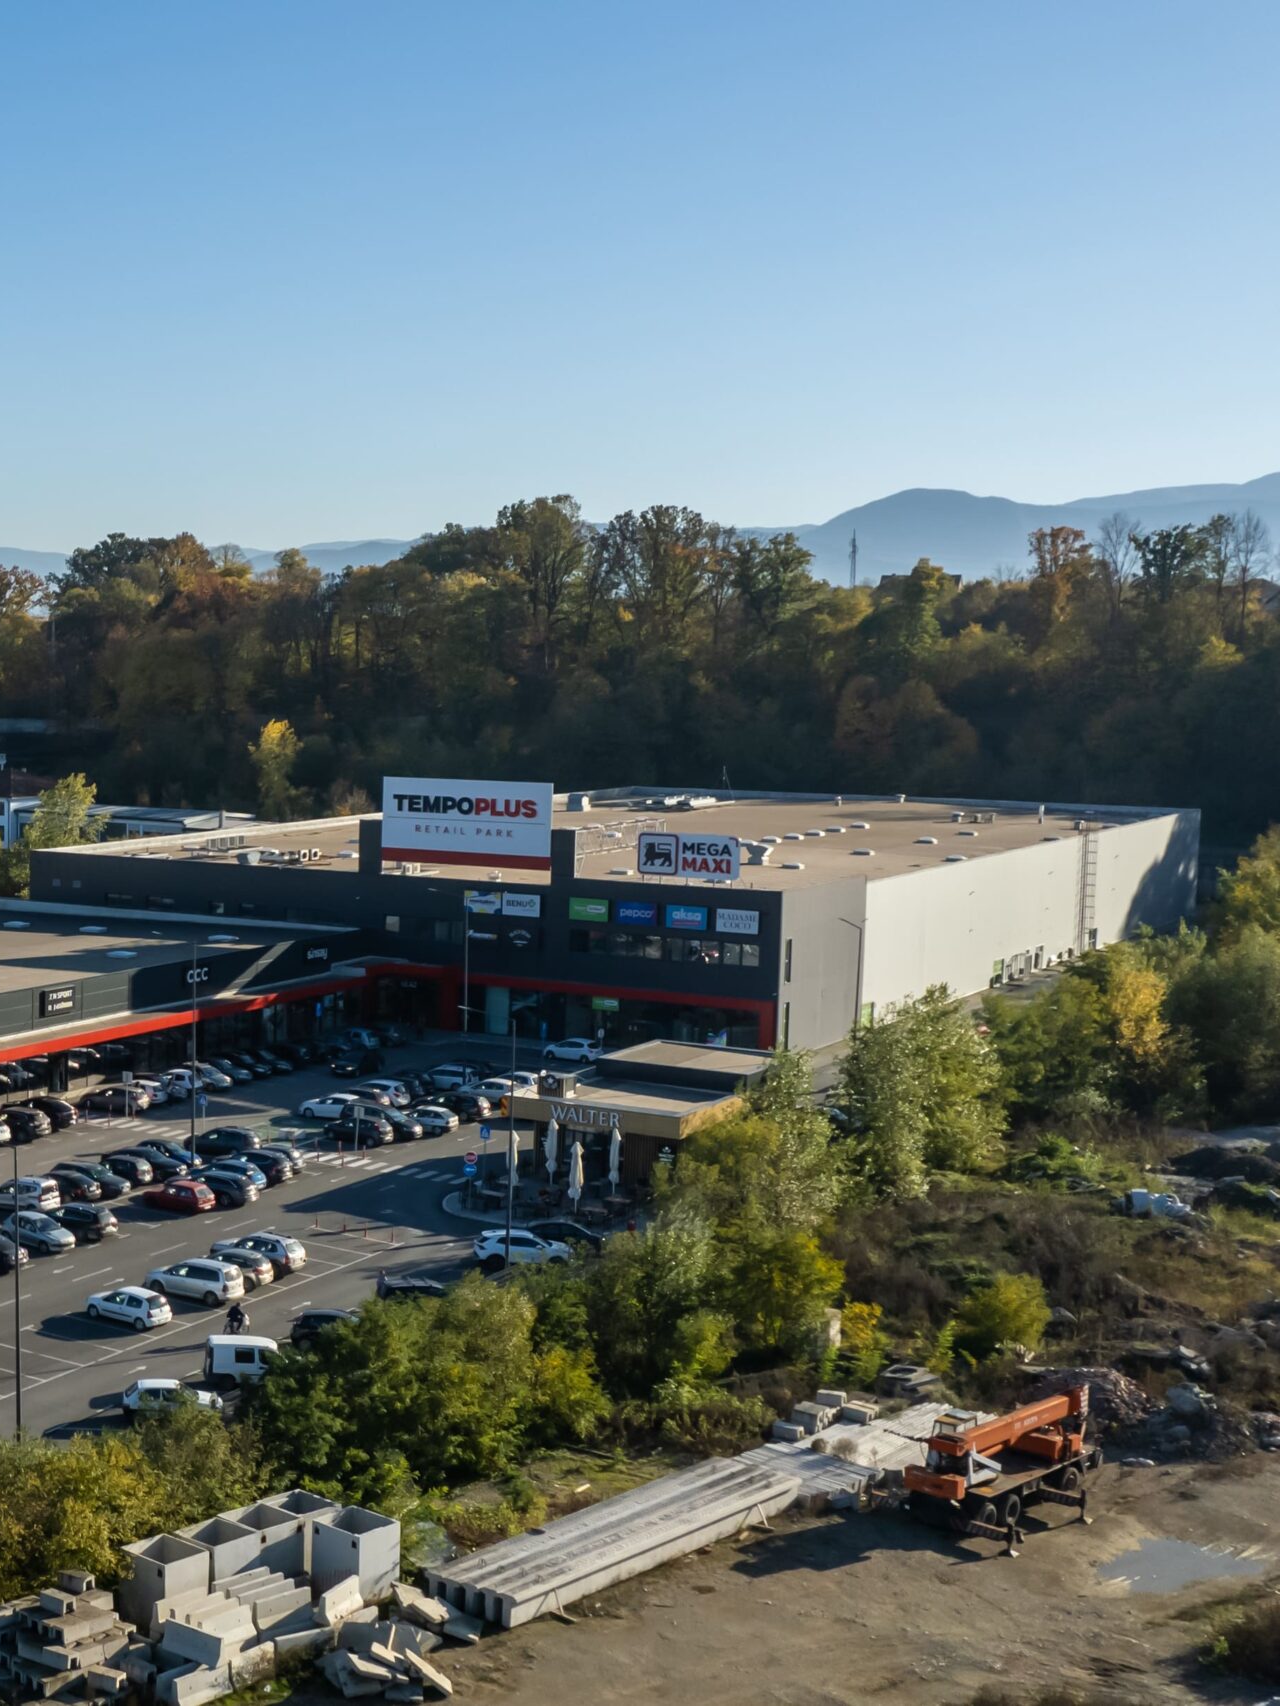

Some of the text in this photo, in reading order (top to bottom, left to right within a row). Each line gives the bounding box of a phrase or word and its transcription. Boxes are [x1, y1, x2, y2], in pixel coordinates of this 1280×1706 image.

[393, 794, 537, 819] TEMPOPLUS
[414, 824, 514, 838] RETAIL PARK
[682, 842, 732, 857] MEGA
[681, 857, 732, 874] MAXI
[506, 899, 527, 908] BENU
[620, 908, 653, 919] pepco
[672, 907, 702, 921] aksa
[186, 967, 209, 983] CCC
[550, 1104, 620, 1127] WALTER
